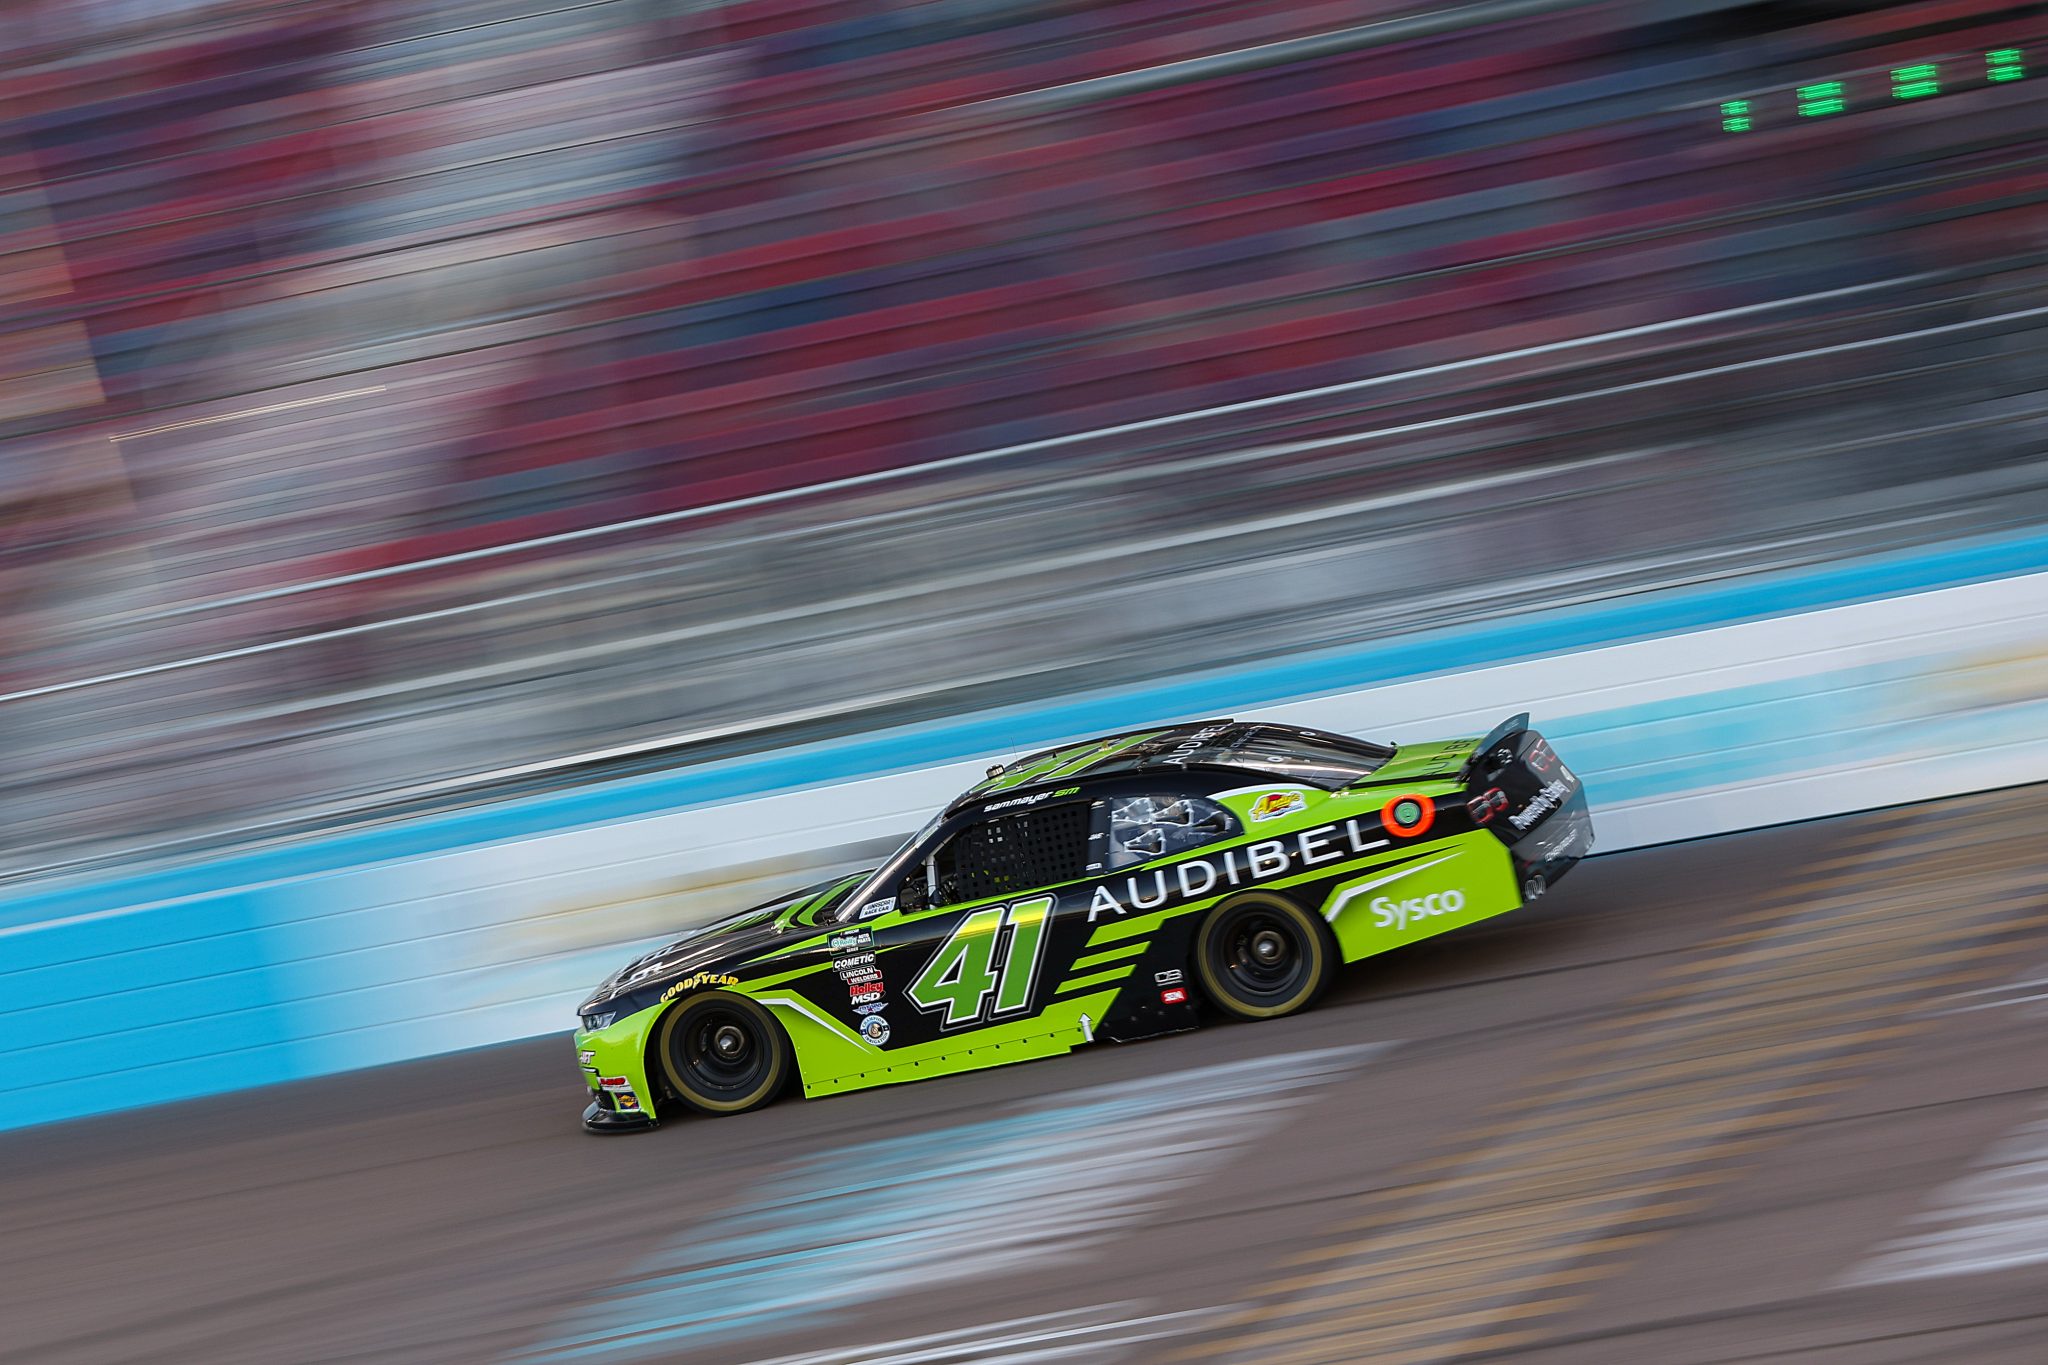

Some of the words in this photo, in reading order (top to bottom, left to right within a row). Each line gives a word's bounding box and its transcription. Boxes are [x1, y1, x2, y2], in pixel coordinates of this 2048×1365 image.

[1087, 819, 1390, 923] AUDIBEL
[1369, 888, 1465, 931] Sysco
[834, 953, 875, 969] COMETIC
[906, 895, 1055, 1028] 41
[842, 966, 874, 979] LINCOLN
[850, 973, 878, 984] WELDERS
[850, 982, 884, 996] Holley
[851, 992, 881, 1005] MSD
[862, 1016, 885, 1028] CHAMPION
[864, 1032, 888, 1044] IRRIGATION
